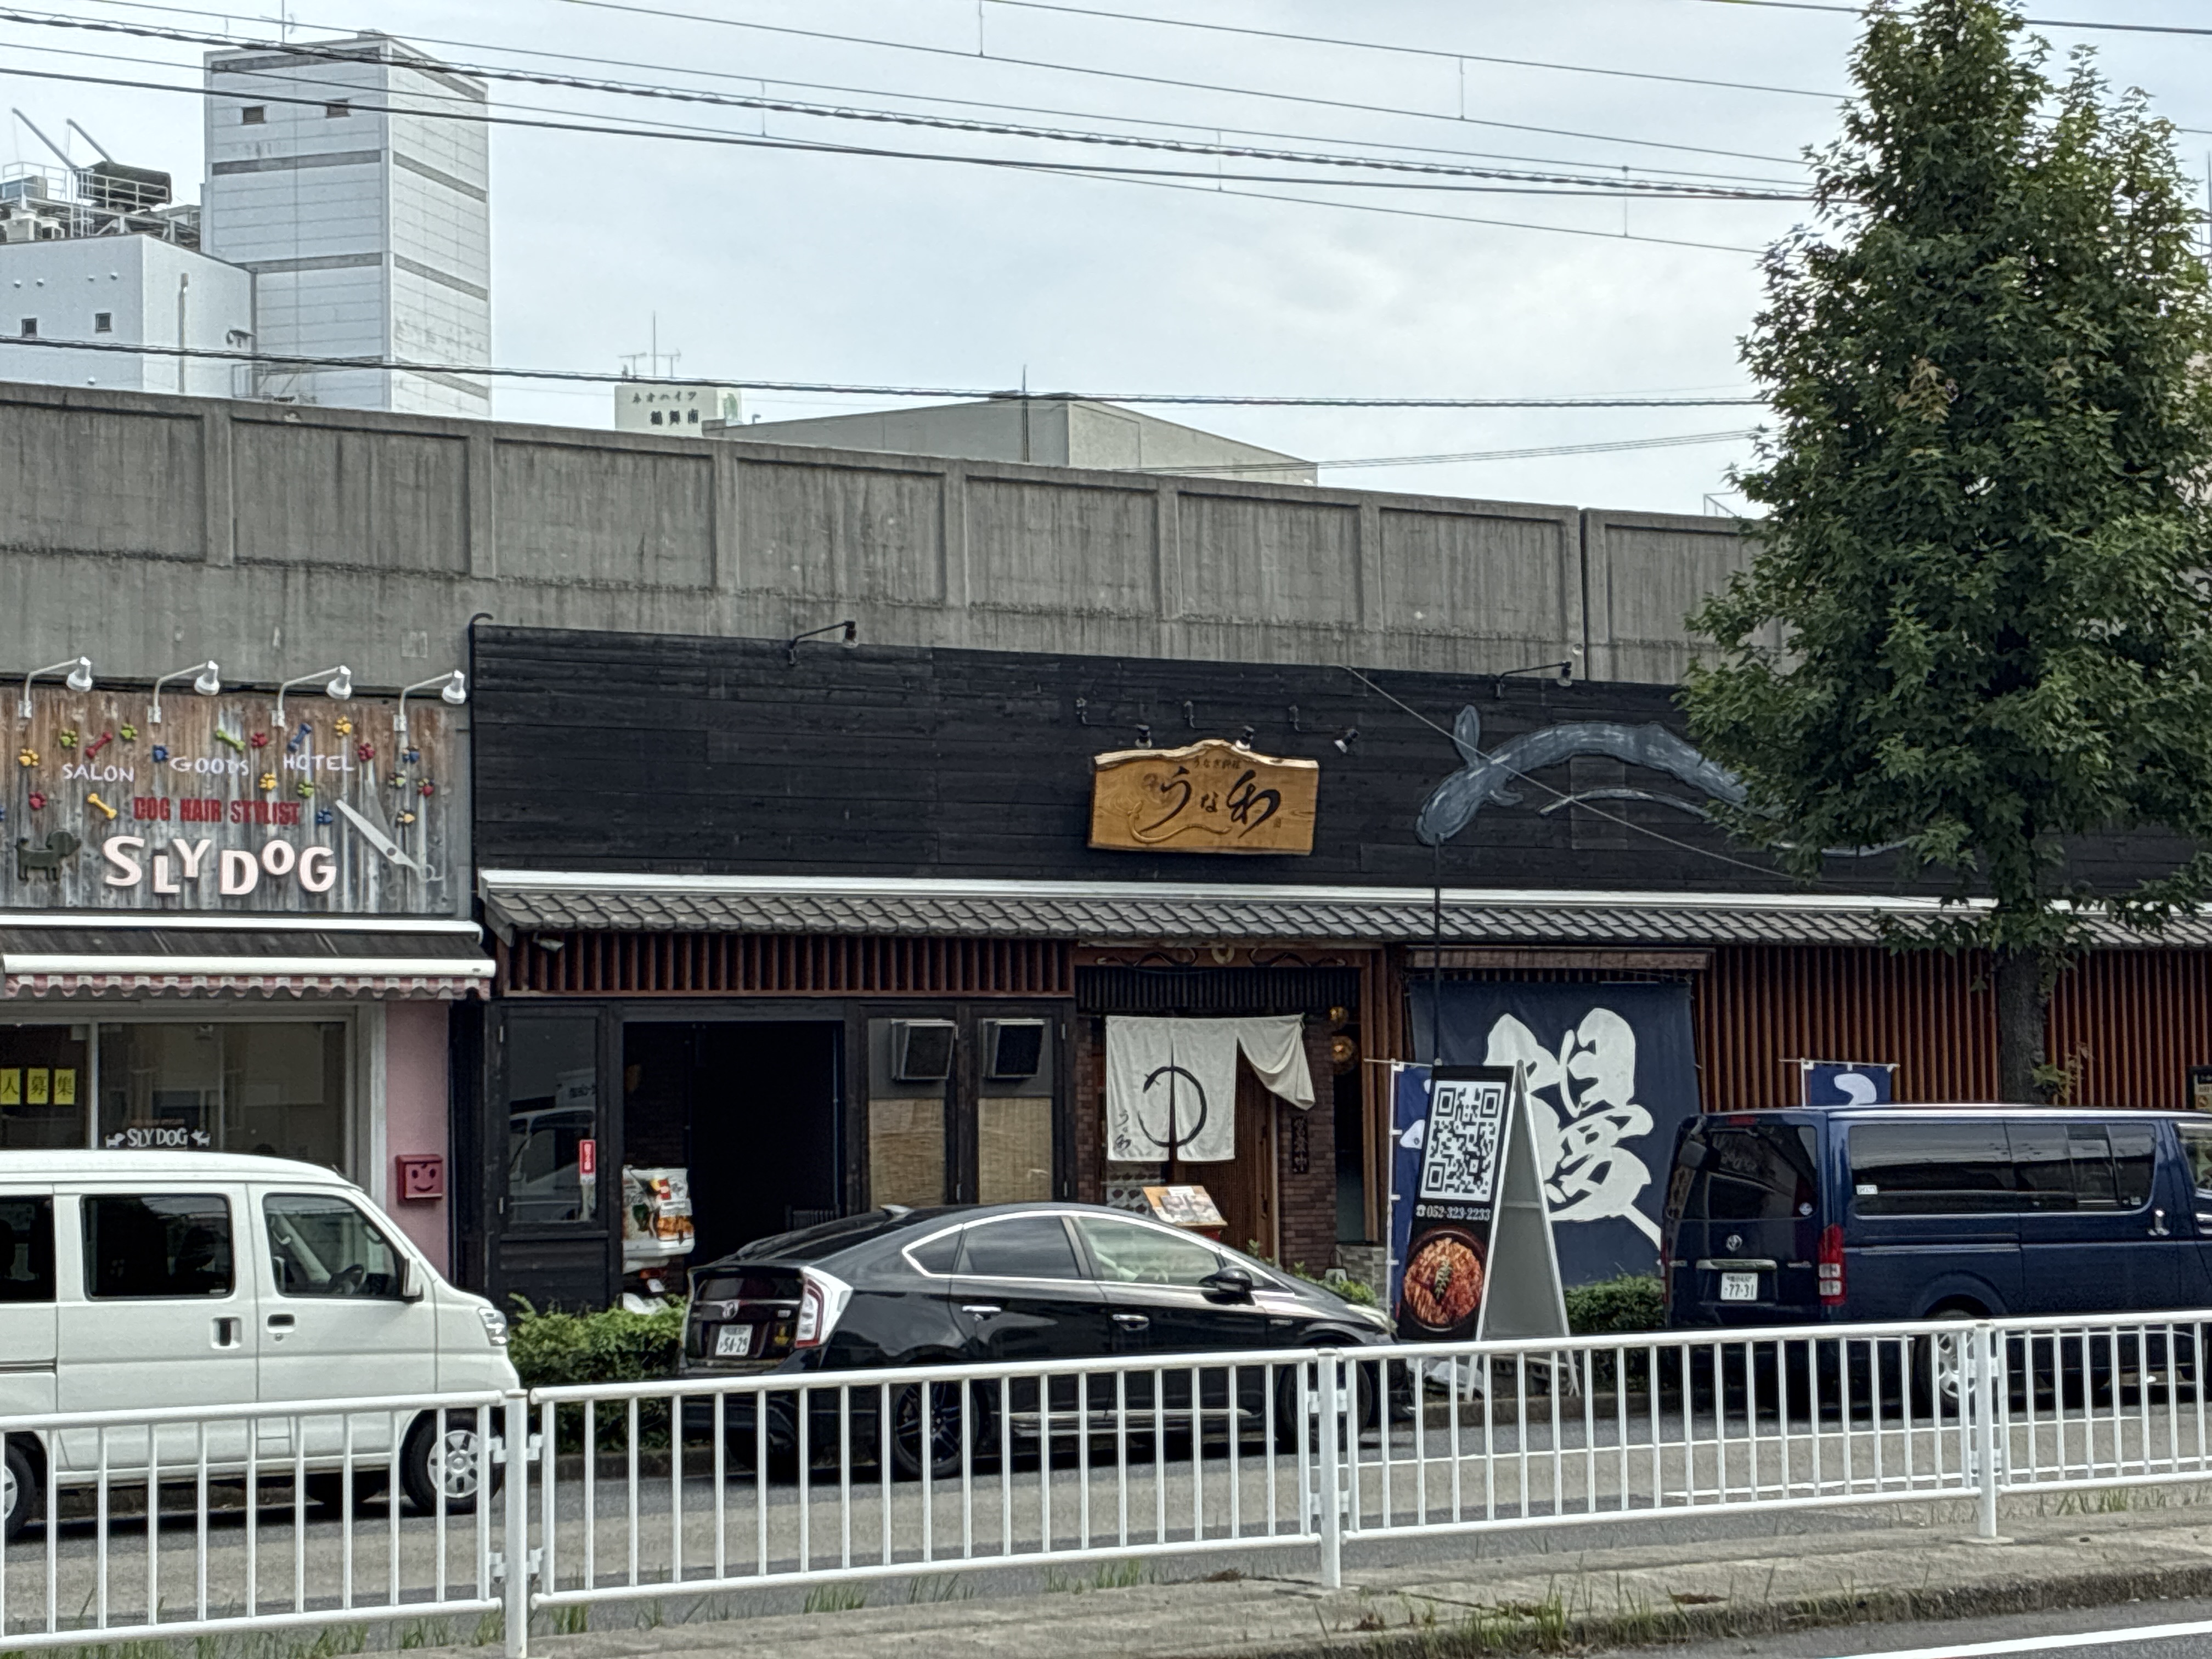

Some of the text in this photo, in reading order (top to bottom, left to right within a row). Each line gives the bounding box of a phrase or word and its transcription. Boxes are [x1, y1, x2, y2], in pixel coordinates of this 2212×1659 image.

[63, 753, 355, 782] SALON GOODS HOTEL
[133, 797, 300, 825] DOG HAIR STYLIST
